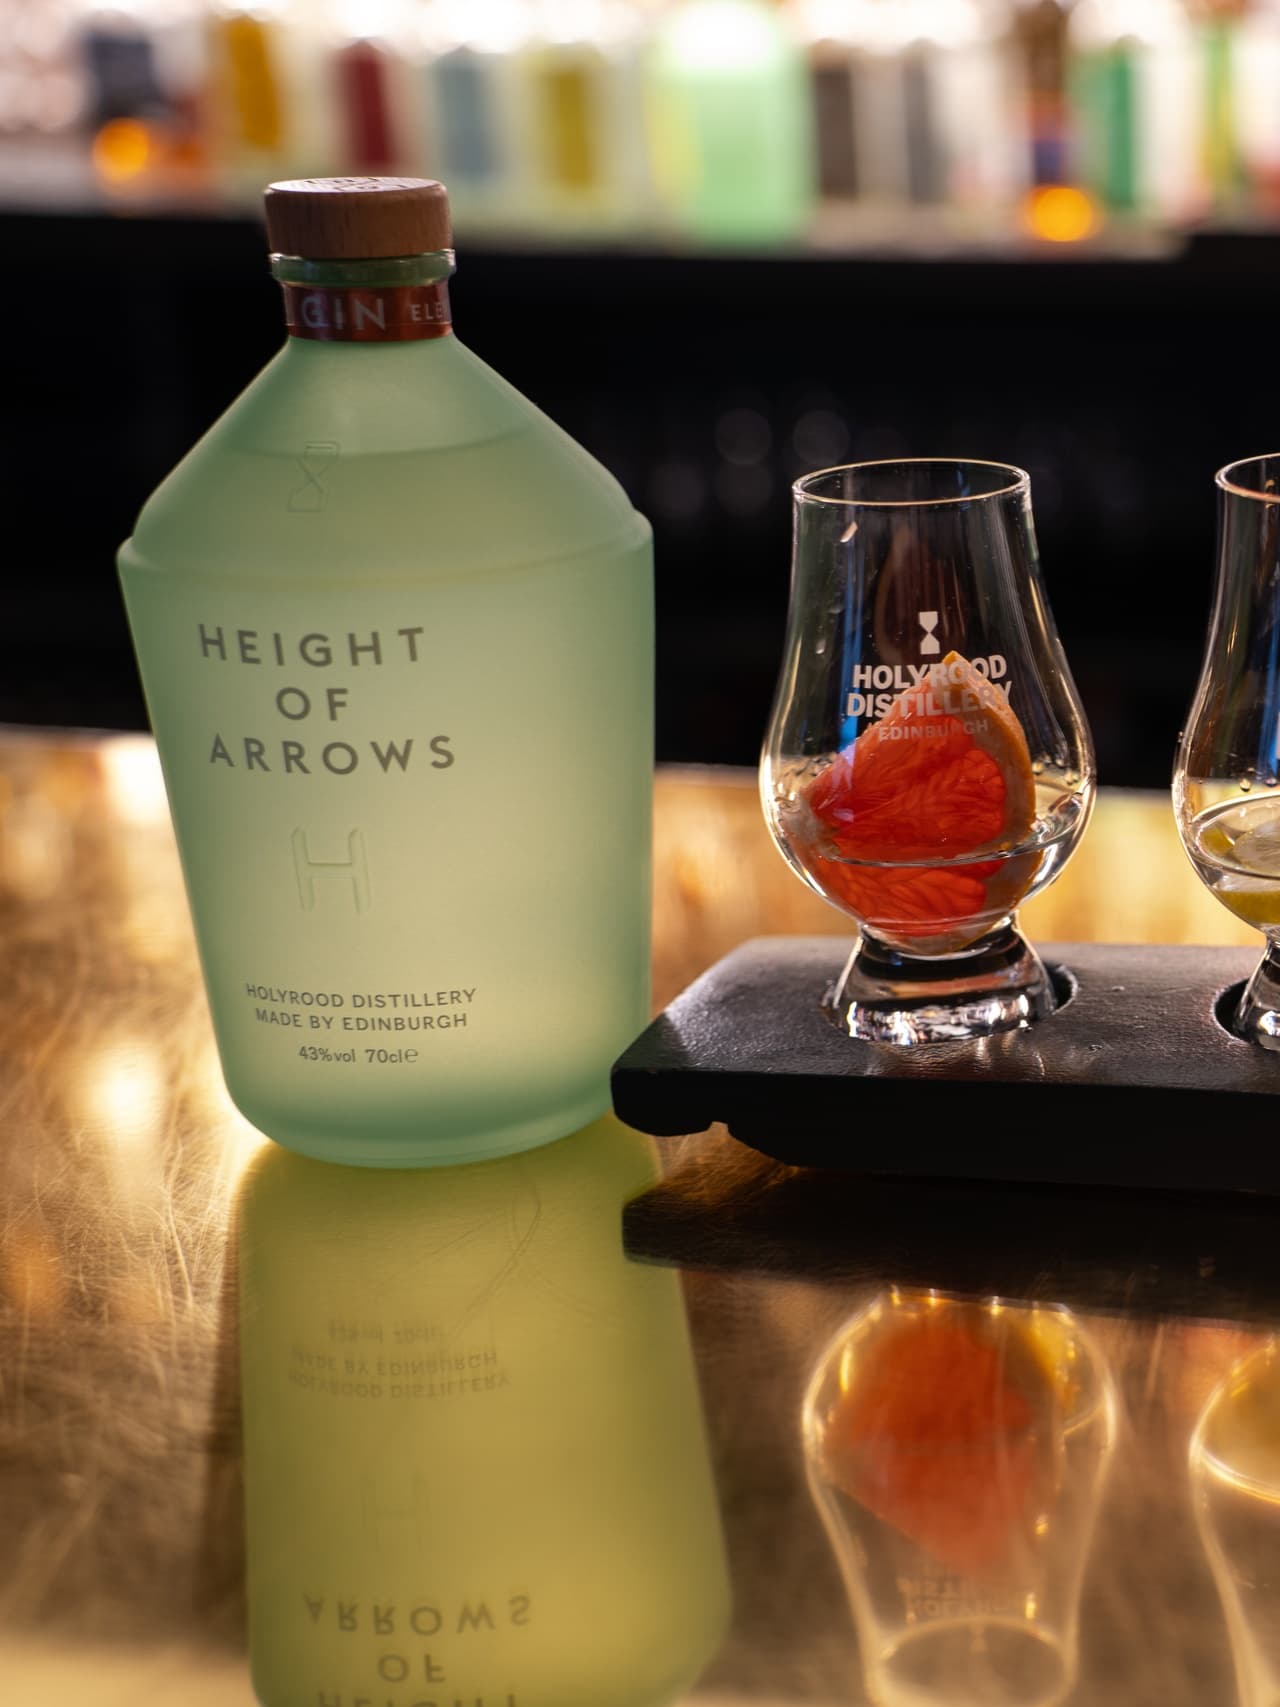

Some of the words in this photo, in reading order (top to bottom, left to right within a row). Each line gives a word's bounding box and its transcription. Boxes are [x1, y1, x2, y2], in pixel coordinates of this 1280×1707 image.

[301, 296, 386, 331] GIN
[197, 622, 425, 668] HEIGHT
[852, 654, 1008, 690] HOLYROOD
[275, 686, 350, 722] OF
[846, 680, 1013, 718] DISTILLERY
[209, 733, 456, 776] ARROWS
[245, 982, 345, 1008] HOLYROOD
[352, 987, 478, 1009] DISTILLERY
[254, 1007, 304, 1028] MADE
[310, 1015, 335, 1031] BY
[342, 1012, 468, 1031] EDINBURGH
